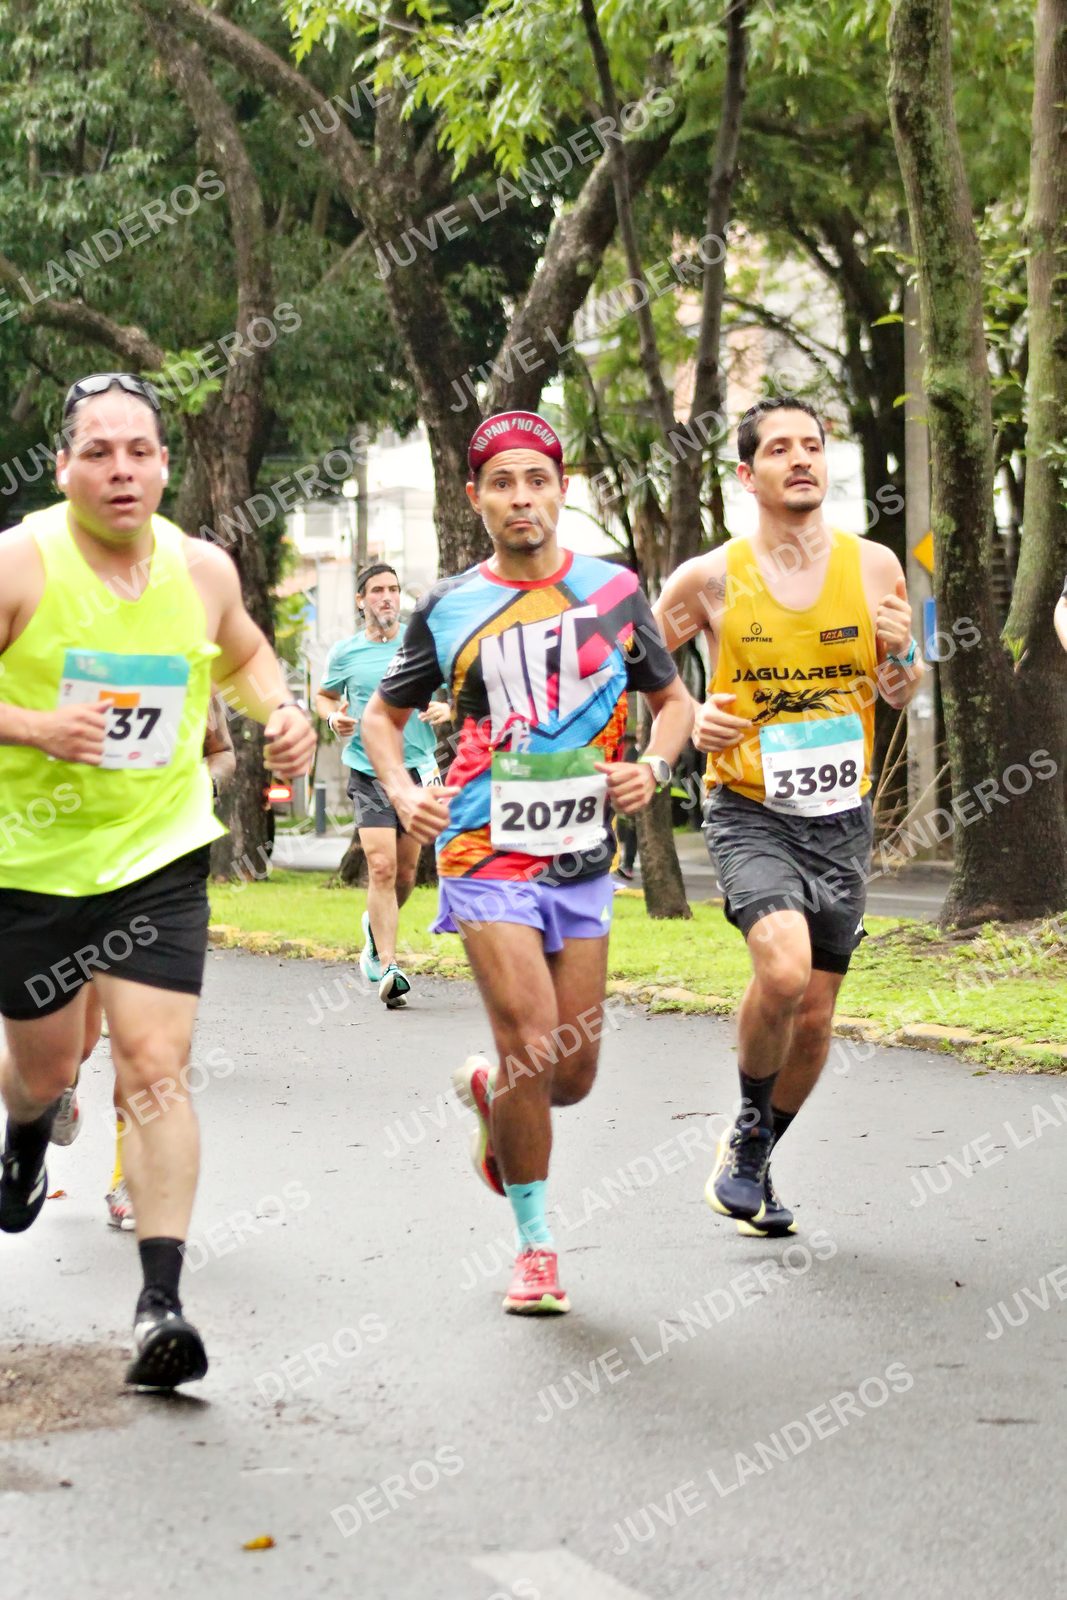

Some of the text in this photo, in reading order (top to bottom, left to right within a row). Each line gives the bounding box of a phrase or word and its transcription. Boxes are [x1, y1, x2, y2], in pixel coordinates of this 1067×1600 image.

[473, 418, 557, 452] NO PAIN NO GAIN
[731, 664, 853, 683] JAGUARES
[107, 707, 162, 741] 37
[773, 759, 858, 799] 3398
[501, 796, 598, 832] 2078
